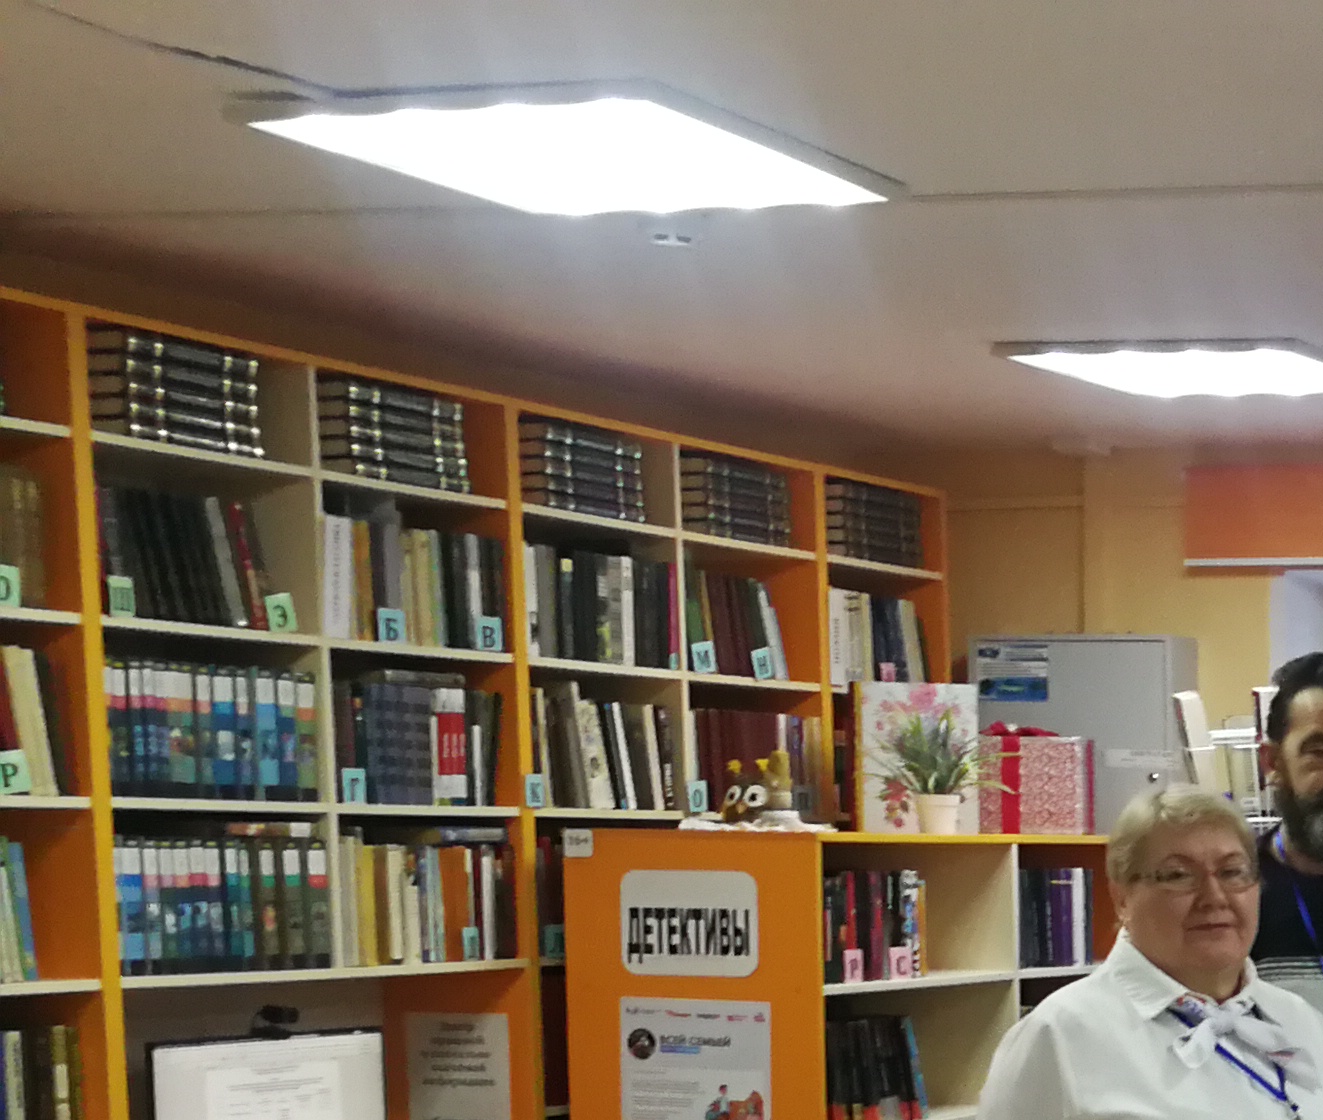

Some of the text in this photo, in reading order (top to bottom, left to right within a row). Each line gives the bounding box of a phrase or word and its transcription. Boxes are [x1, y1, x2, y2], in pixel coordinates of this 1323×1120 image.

[272, 604, 289, 628] Э
[381, 618, 400, 641] Б
[481, 625, 496, 648] В
[695, 649, 712, 668] М
[0, 763, 19, 789] Р
[692, 787, 703, 808] О
[627, 907, 750, 964] ДЕТЕКТИВЫ
[896, 955, 907, 973] С
